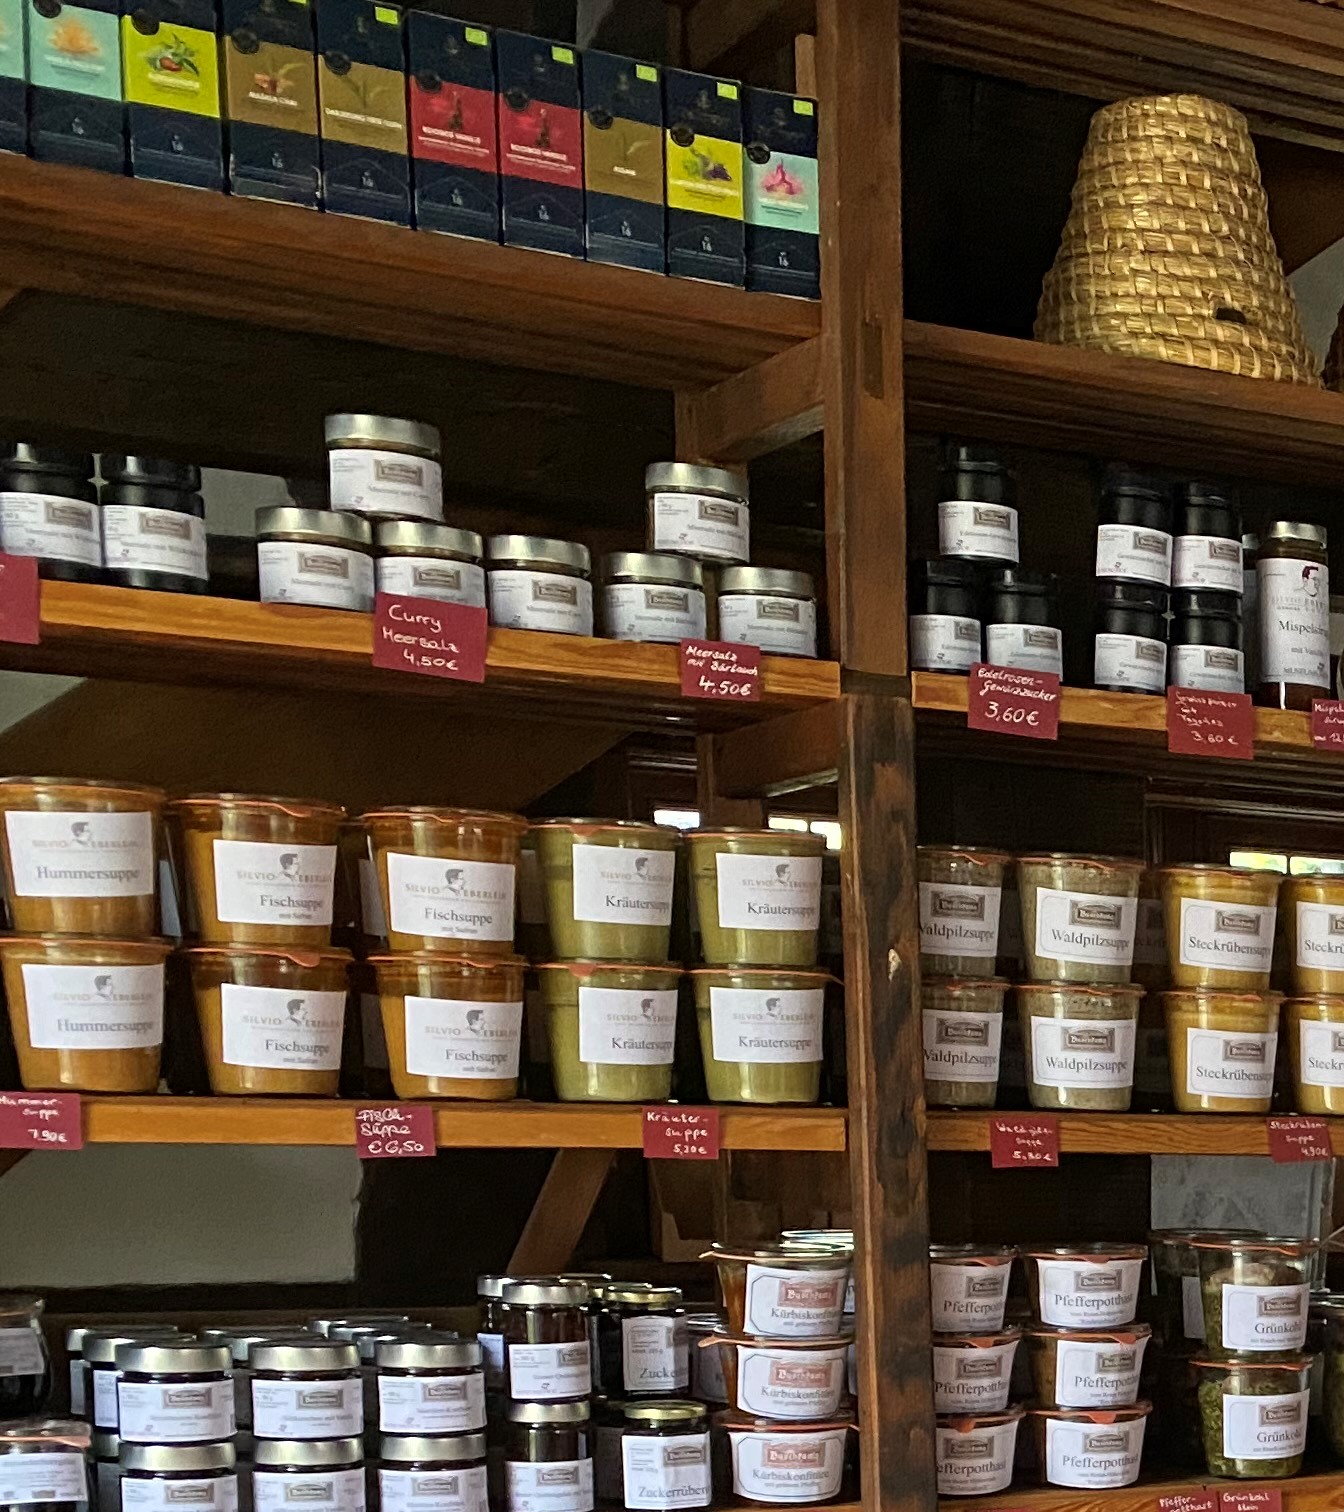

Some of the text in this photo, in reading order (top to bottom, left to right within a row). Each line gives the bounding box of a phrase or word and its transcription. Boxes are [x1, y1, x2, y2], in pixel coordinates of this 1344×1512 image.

[388, 604, 442, 633] Curry
[381, 626, 460, 654] Meersalz
[402, 650, 459, 672] 4,50€
[699, 675, 752, 696] 4,50€
[984, 701, 1040, 727] 3,60€
[36, 866, 140, 883] Hummersuppe
[259, 894, 324, 911] Fischsuppe
[424, 908, 493, 925] Fischsuppe
[1051, 929, 1130, 950] Waldpilzsuppe
[264, 1038, 330, 1054] Fischsuppe
[444, 1048, 509, 1064] Fischsuppe
[1045, 1056, 1127, 1074] Waldpilzsuppe
